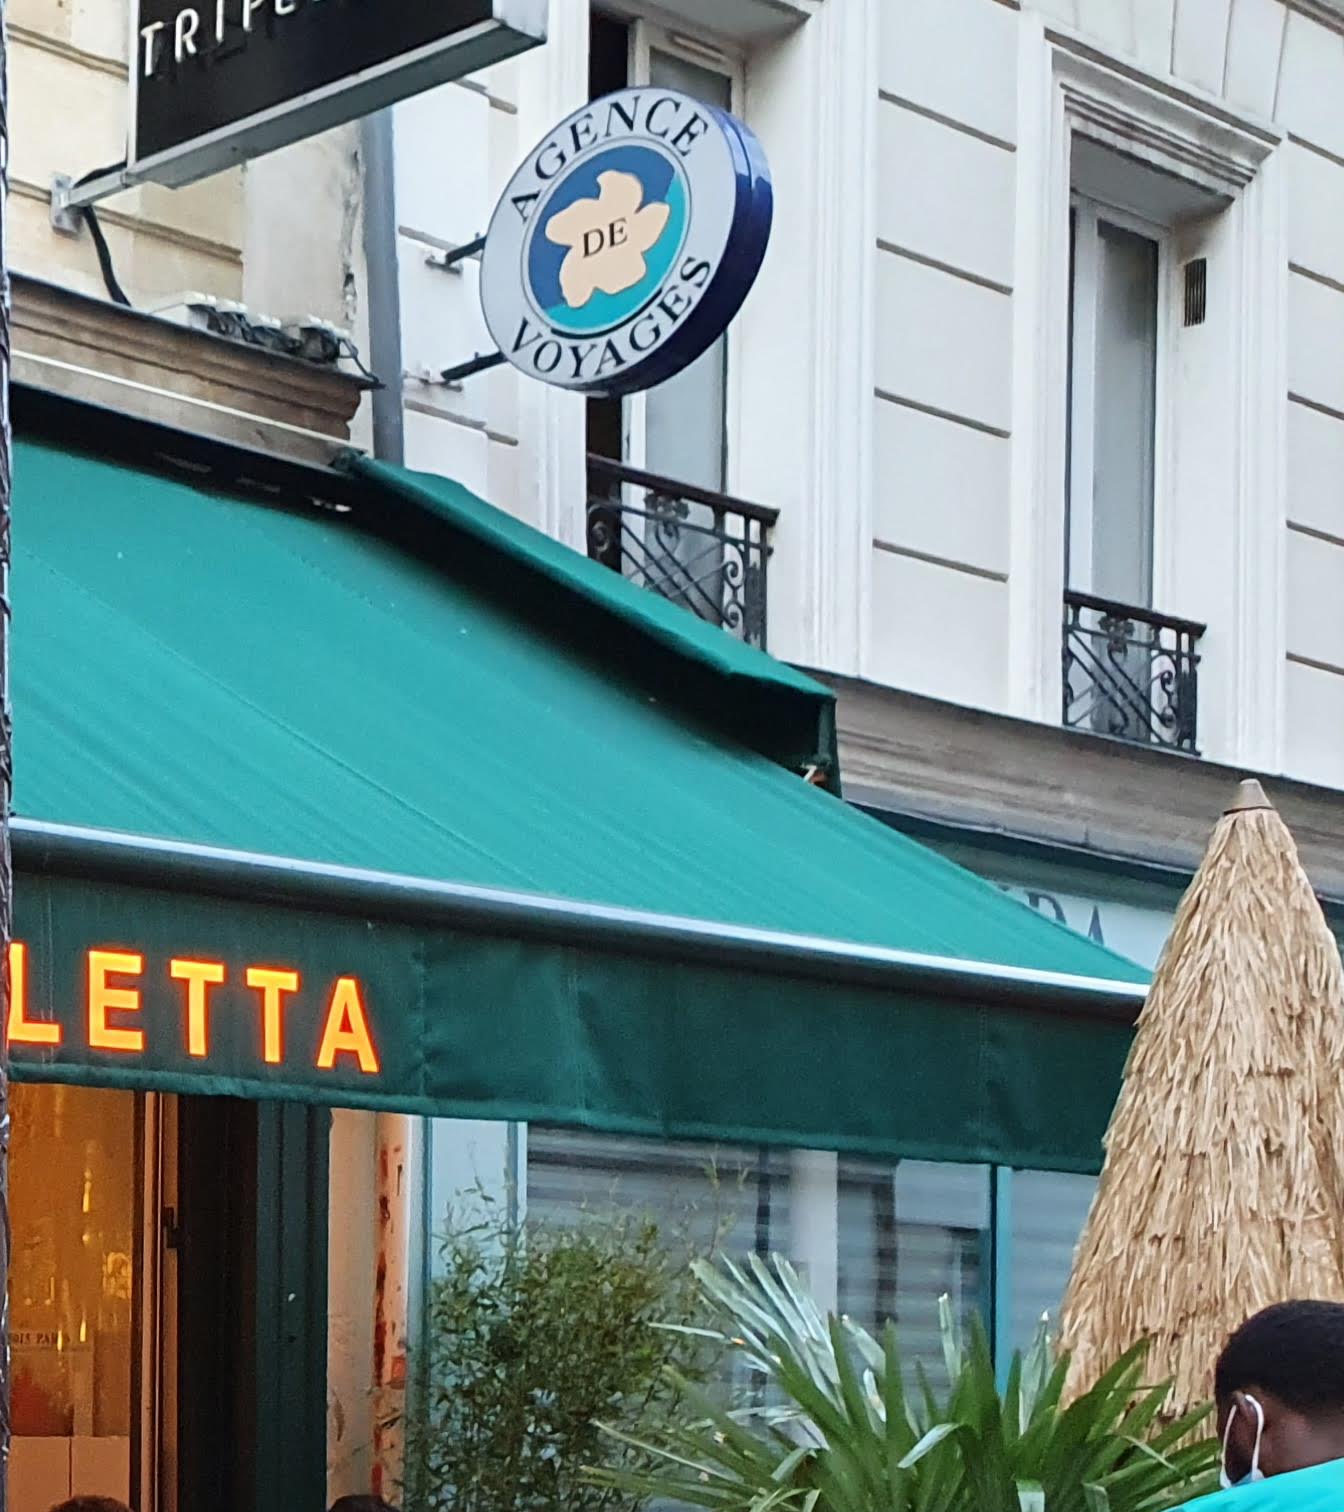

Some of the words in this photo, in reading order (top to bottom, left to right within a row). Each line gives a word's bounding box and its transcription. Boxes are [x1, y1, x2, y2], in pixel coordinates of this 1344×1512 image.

[510, 95, 709, 223] AGENCE
[581, 216, 629, 259] DE
[511, 256, 711, 379] VOYAGES
